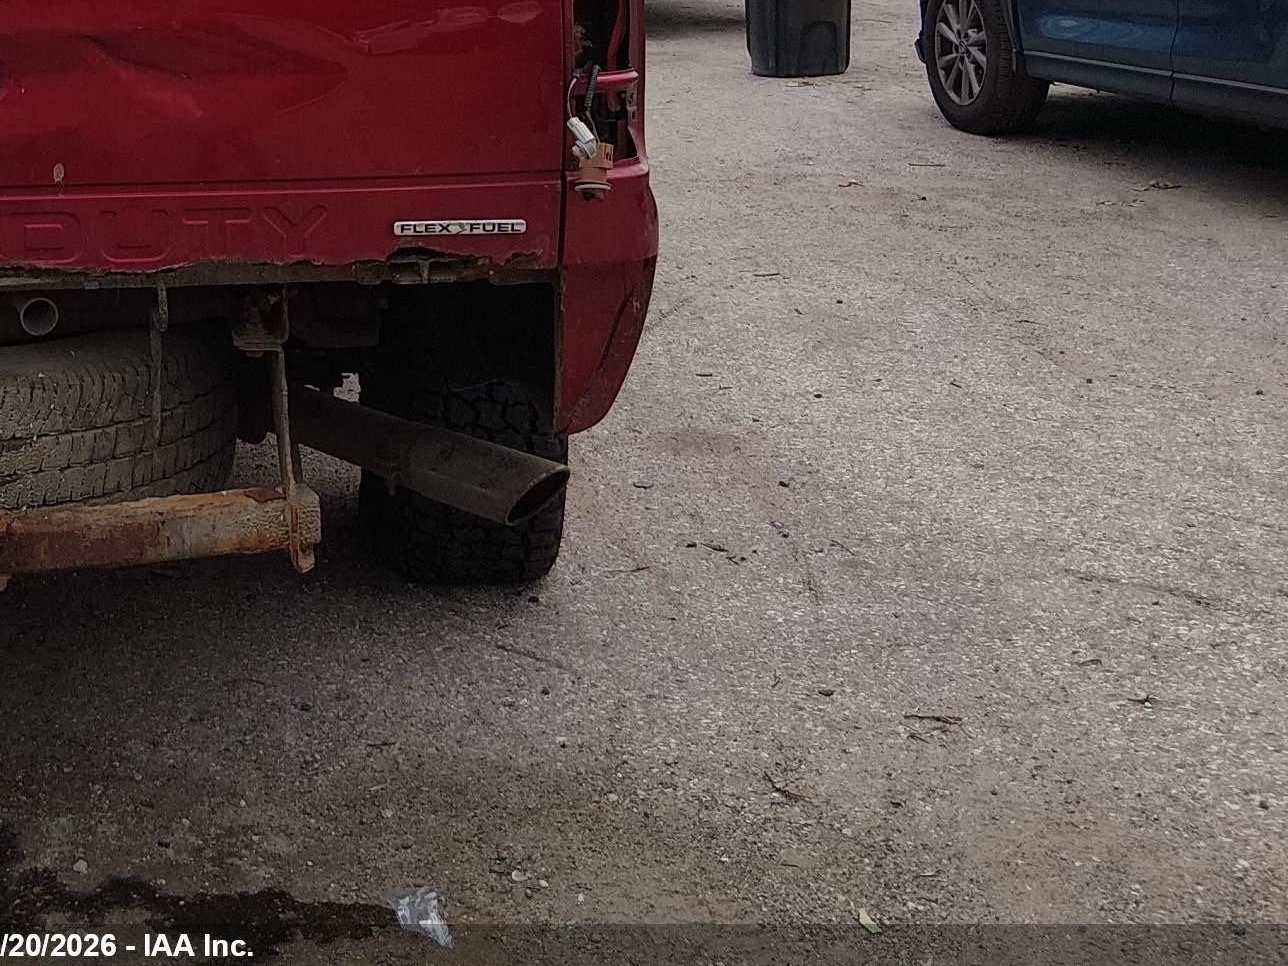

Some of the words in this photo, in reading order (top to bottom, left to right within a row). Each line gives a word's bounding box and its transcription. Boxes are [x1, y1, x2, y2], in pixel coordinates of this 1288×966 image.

[9, 203, 329, 264] DUTY
[399, 223, 452, 234] FLEX
[469, 222, 522, 233] FUEL
